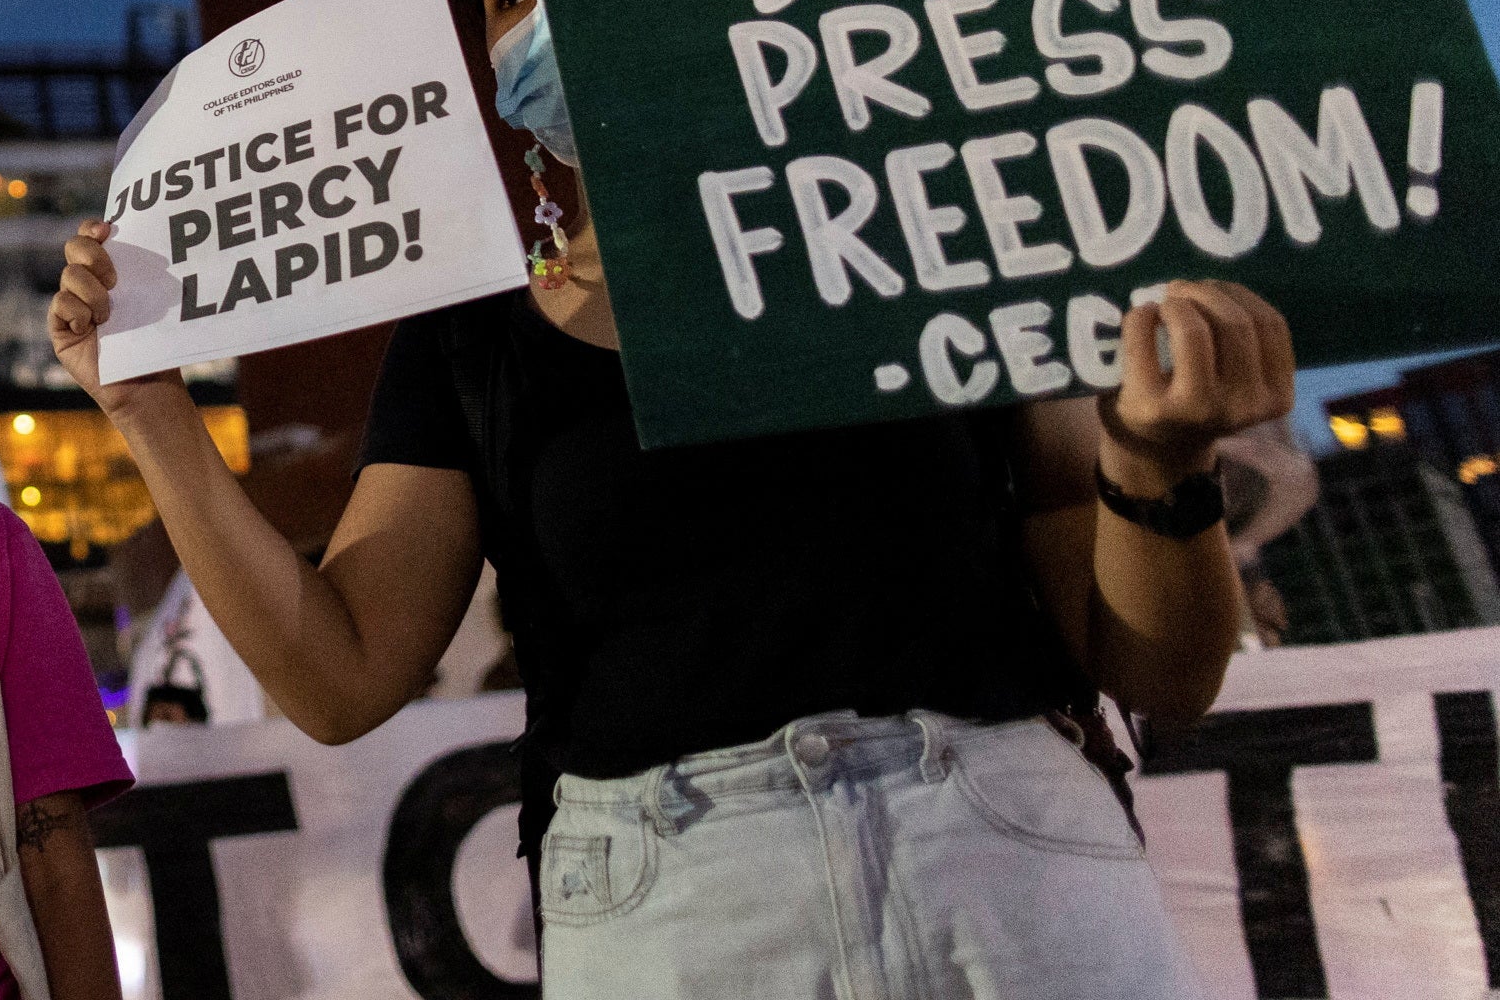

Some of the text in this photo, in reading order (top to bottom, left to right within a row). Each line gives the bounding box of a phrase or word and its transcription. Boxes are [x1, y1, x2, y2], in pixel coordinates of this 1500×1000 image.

[203, 69, 302, 111] COLLEGE EDITORS GUILD
[213, 83, 295, 117] OF THE PHILIPPINES
[109, 80, 451, 224] JUSTICE FOR
[168, 146, 403, 265] PERCY
[697, 81, 1444, 320] FREEDOM!
[179, 208, 424, 322] LAPID!
